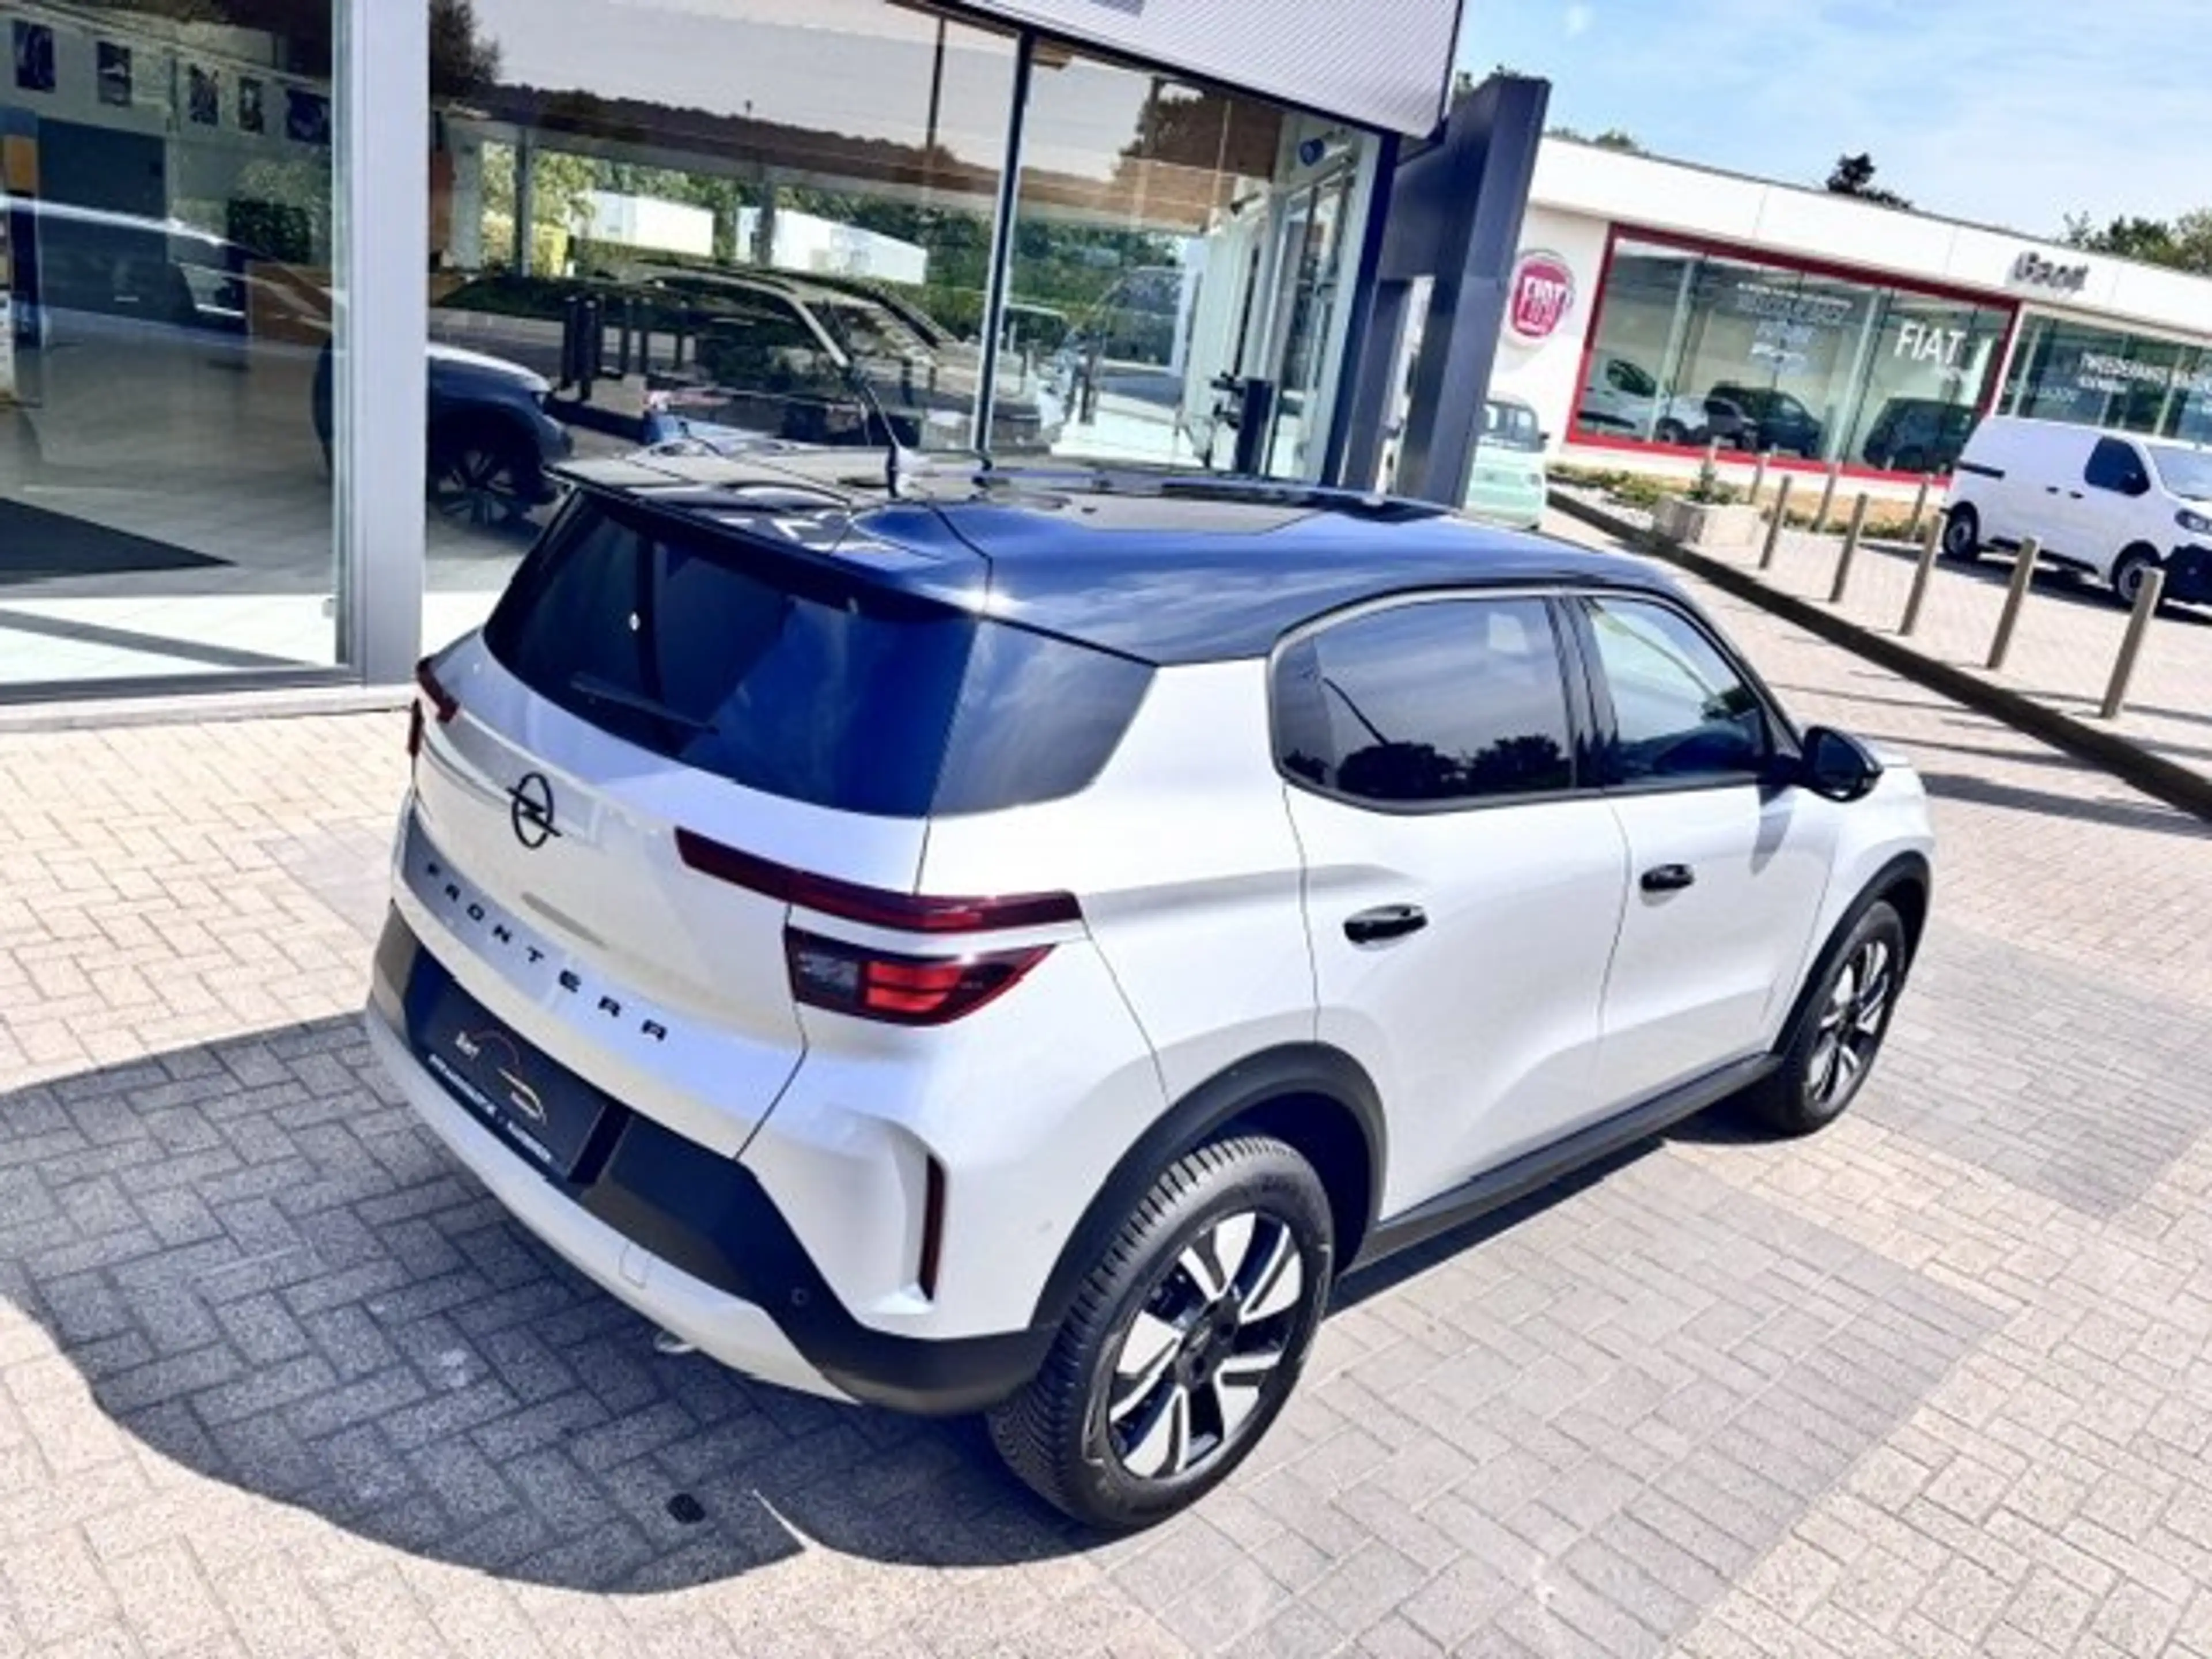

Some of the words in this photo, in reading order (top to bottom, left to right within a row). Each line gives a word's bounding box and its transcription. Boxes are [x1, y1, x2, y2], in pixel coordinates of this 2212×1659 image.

[1517, 275, 1568, 328] FIAT
[1894, 319, 1967, 365] FIAT
[427, 863, 667, 1041] FRONTERA
